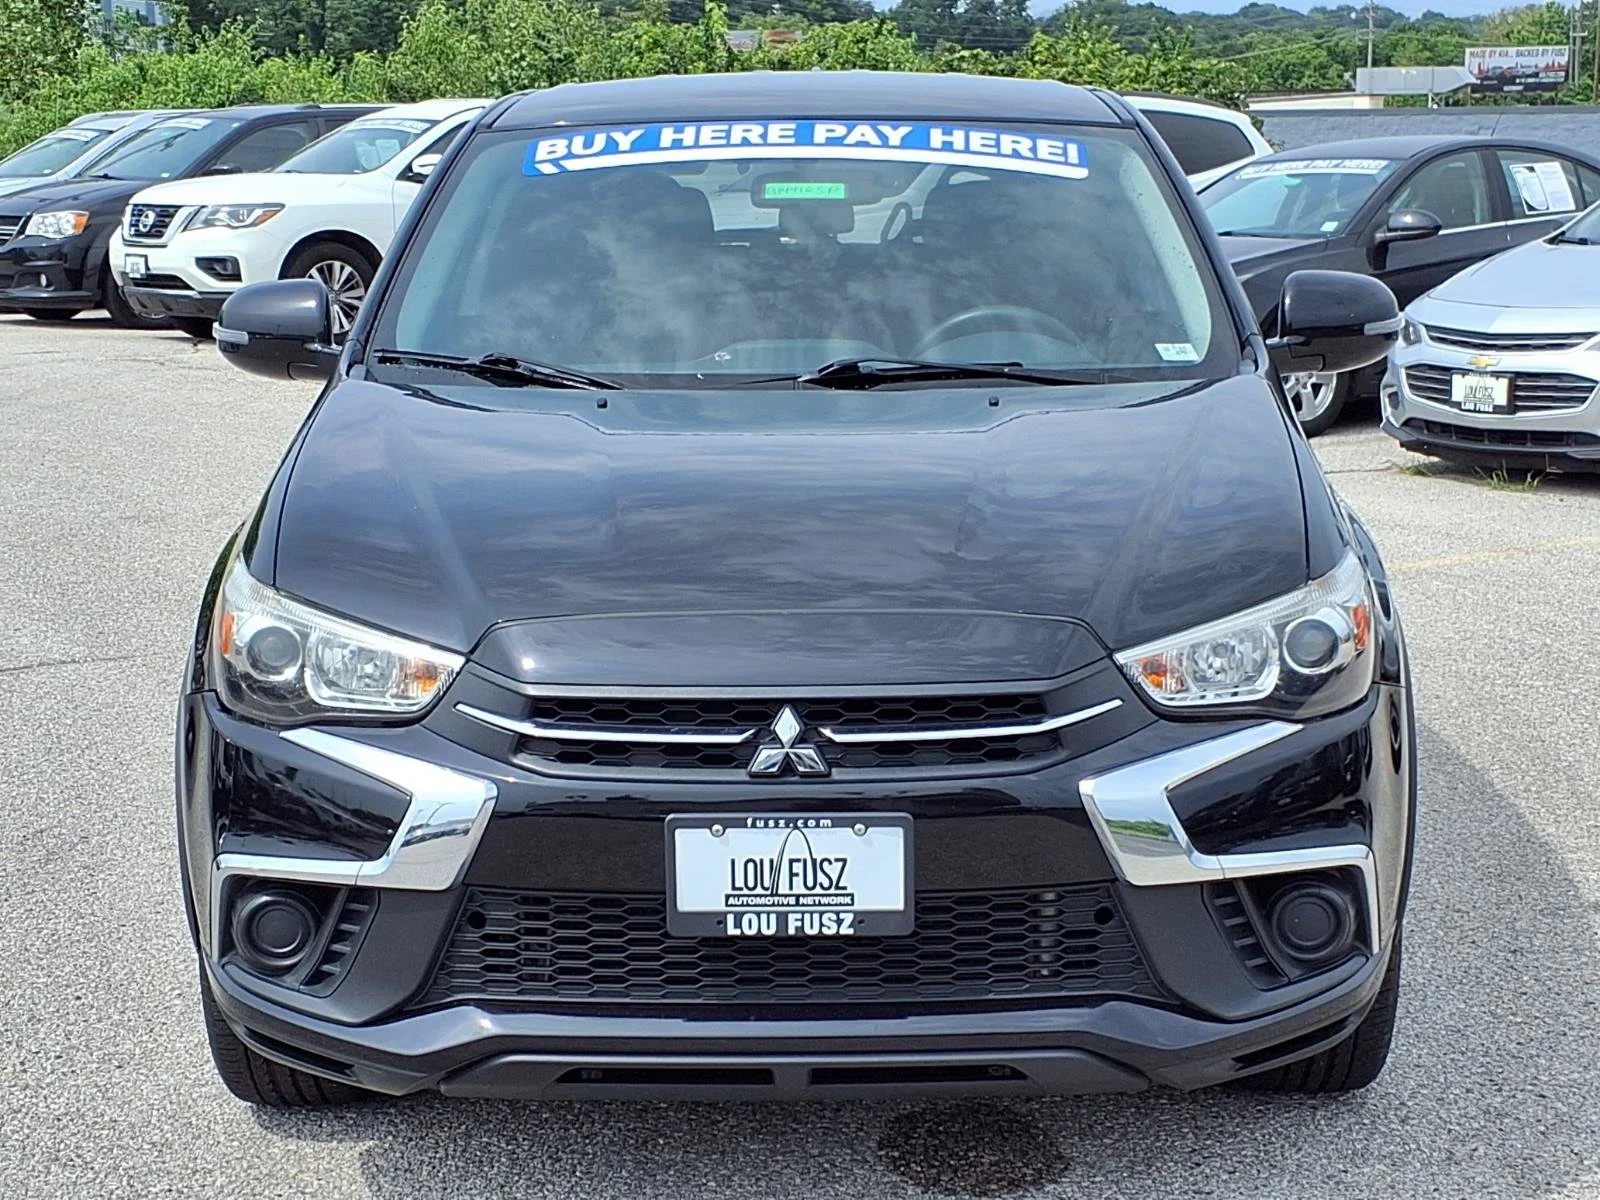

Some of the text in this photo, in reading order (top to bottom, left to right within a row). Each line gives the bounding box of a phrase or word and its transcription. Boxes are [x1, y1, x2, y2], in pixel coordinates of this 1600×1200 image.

[535, 123, 1080, 164] BUY HERE PAY HERE!
[746, 817, 832, 828] fusz.com
[731, 858, 848, 892] LOU FUSZ
[727, 895, 852, 906] AUTOMOTIVE NETWORK
[726, 913, 855, 935] LOU FUSZ
